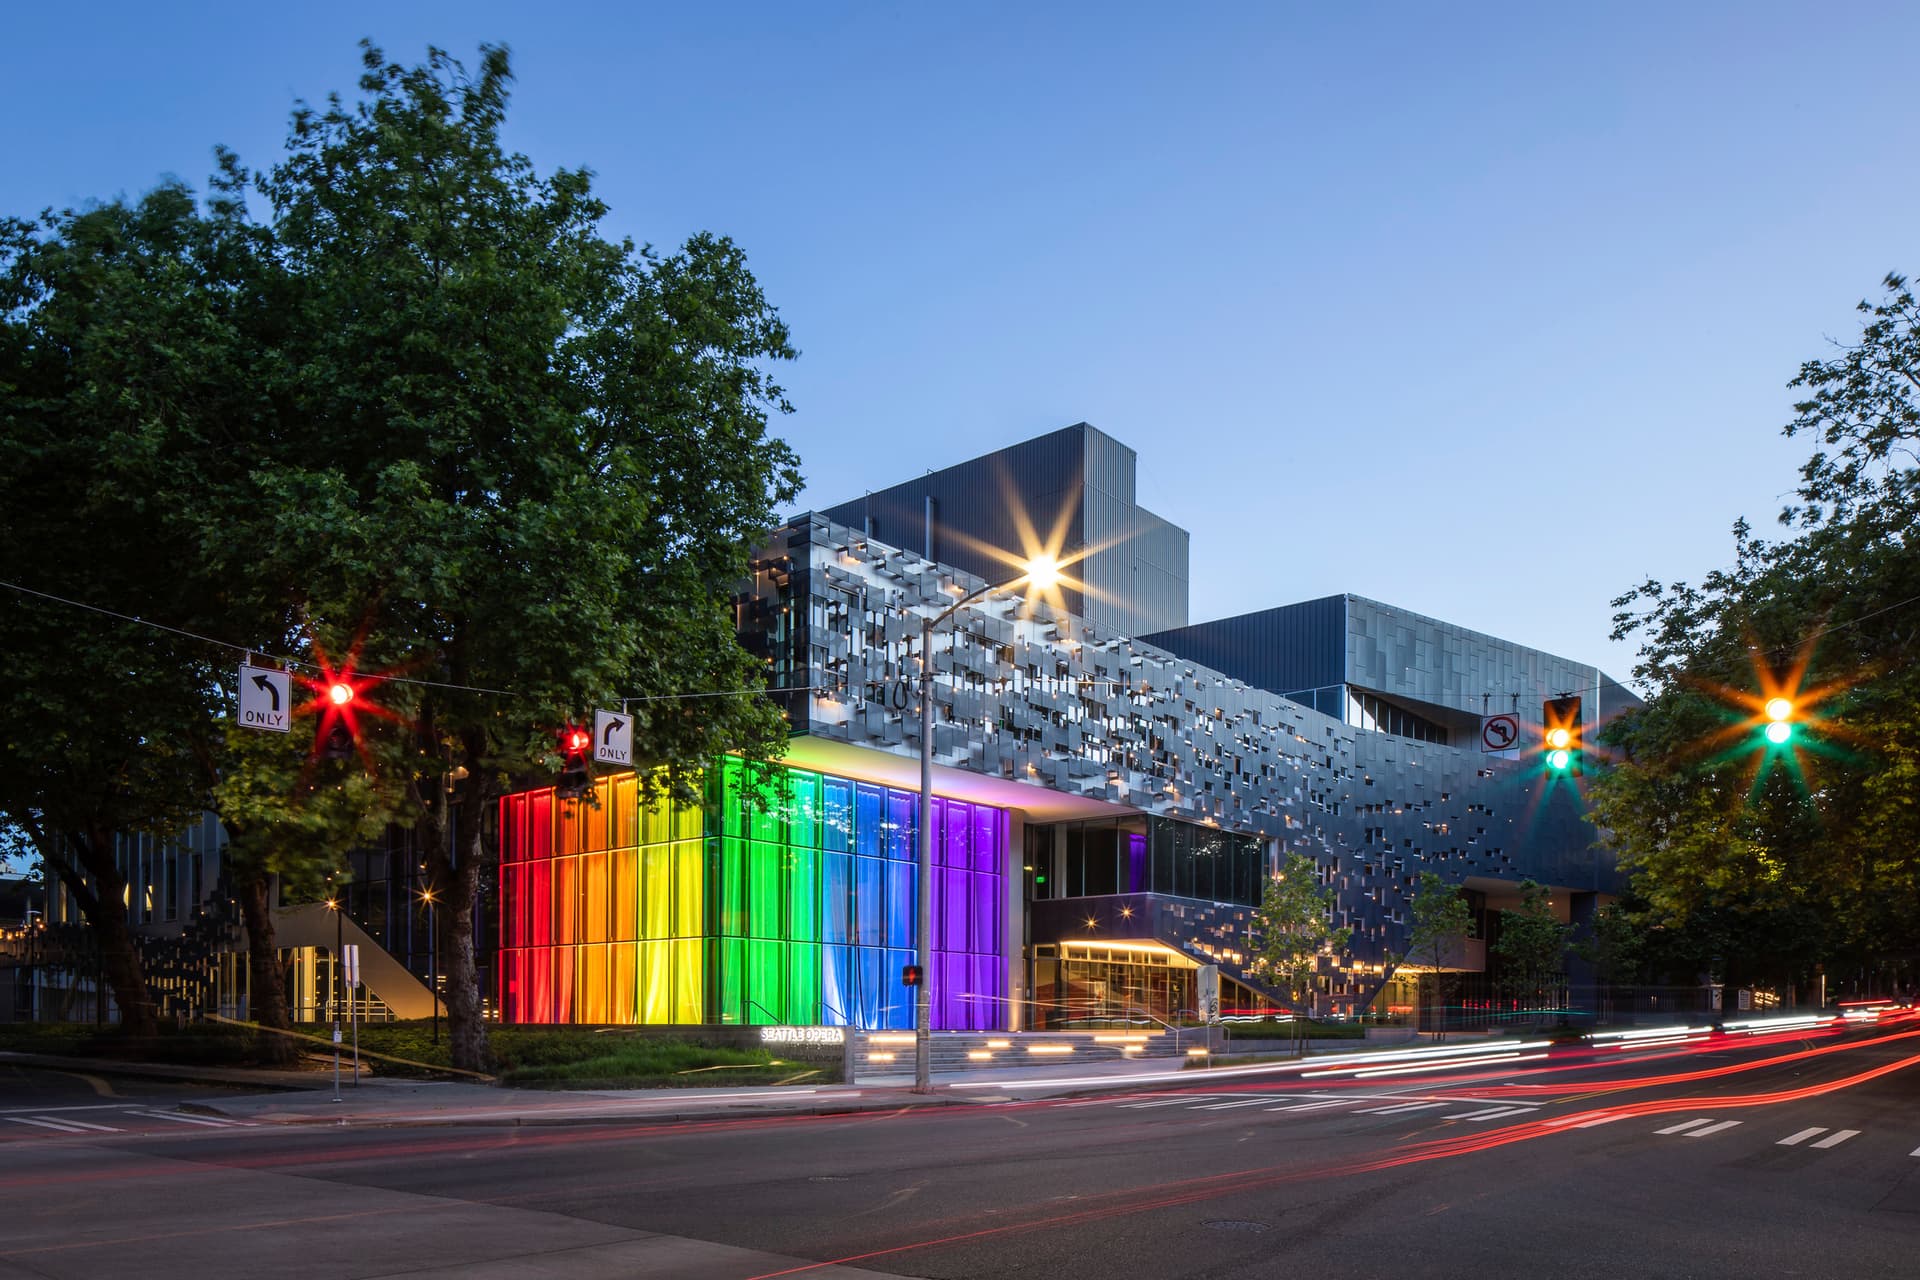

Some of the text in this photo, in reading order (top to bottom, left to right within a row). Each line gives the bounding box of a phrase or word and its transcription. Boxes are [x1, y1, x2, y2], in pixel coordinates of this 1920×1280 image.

[246, 711, 283, 726] ONLY
[600, 748, 627, 760] ONLY
[761, 1028, 842, 1041] SEATTLE OPERA
